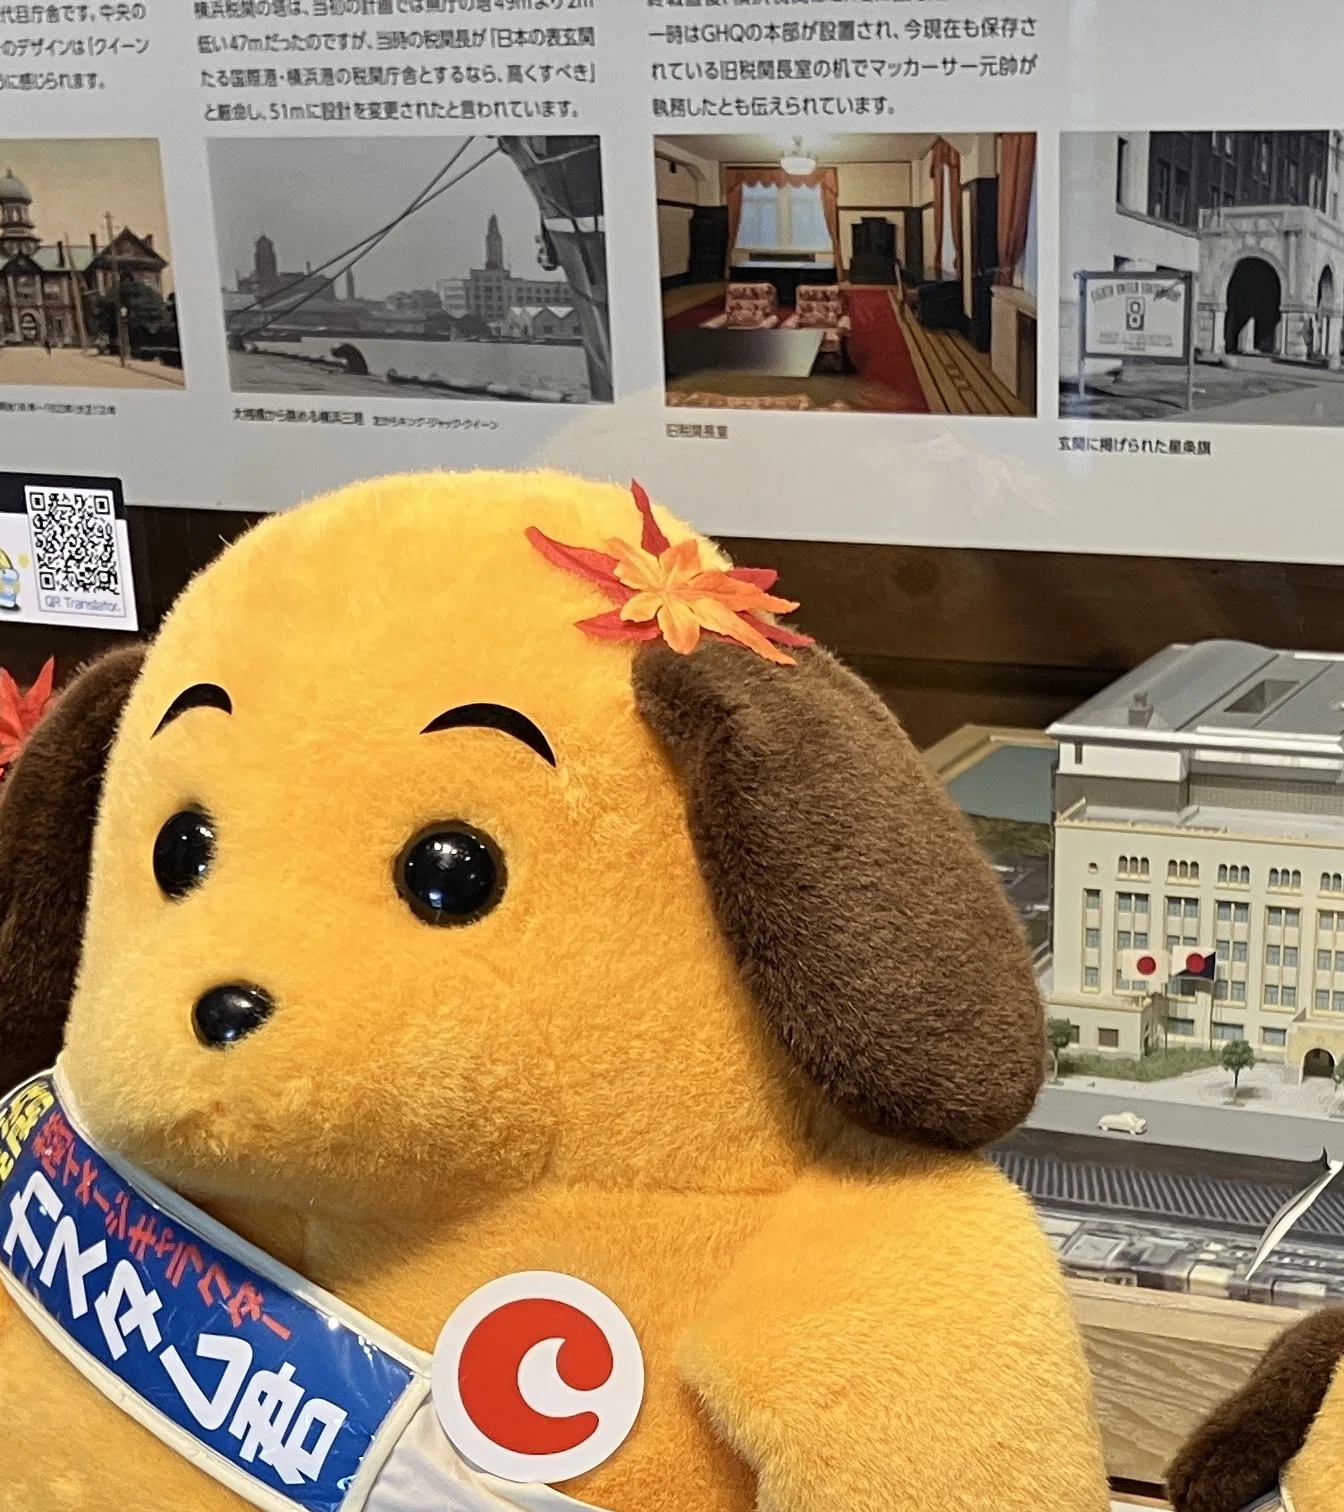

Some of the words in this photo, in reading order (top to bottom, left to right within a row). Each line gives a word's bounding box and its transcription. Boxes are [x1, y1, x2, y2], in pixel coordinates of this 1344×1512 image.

[3, 1168, 348, 1488] カスタム君
